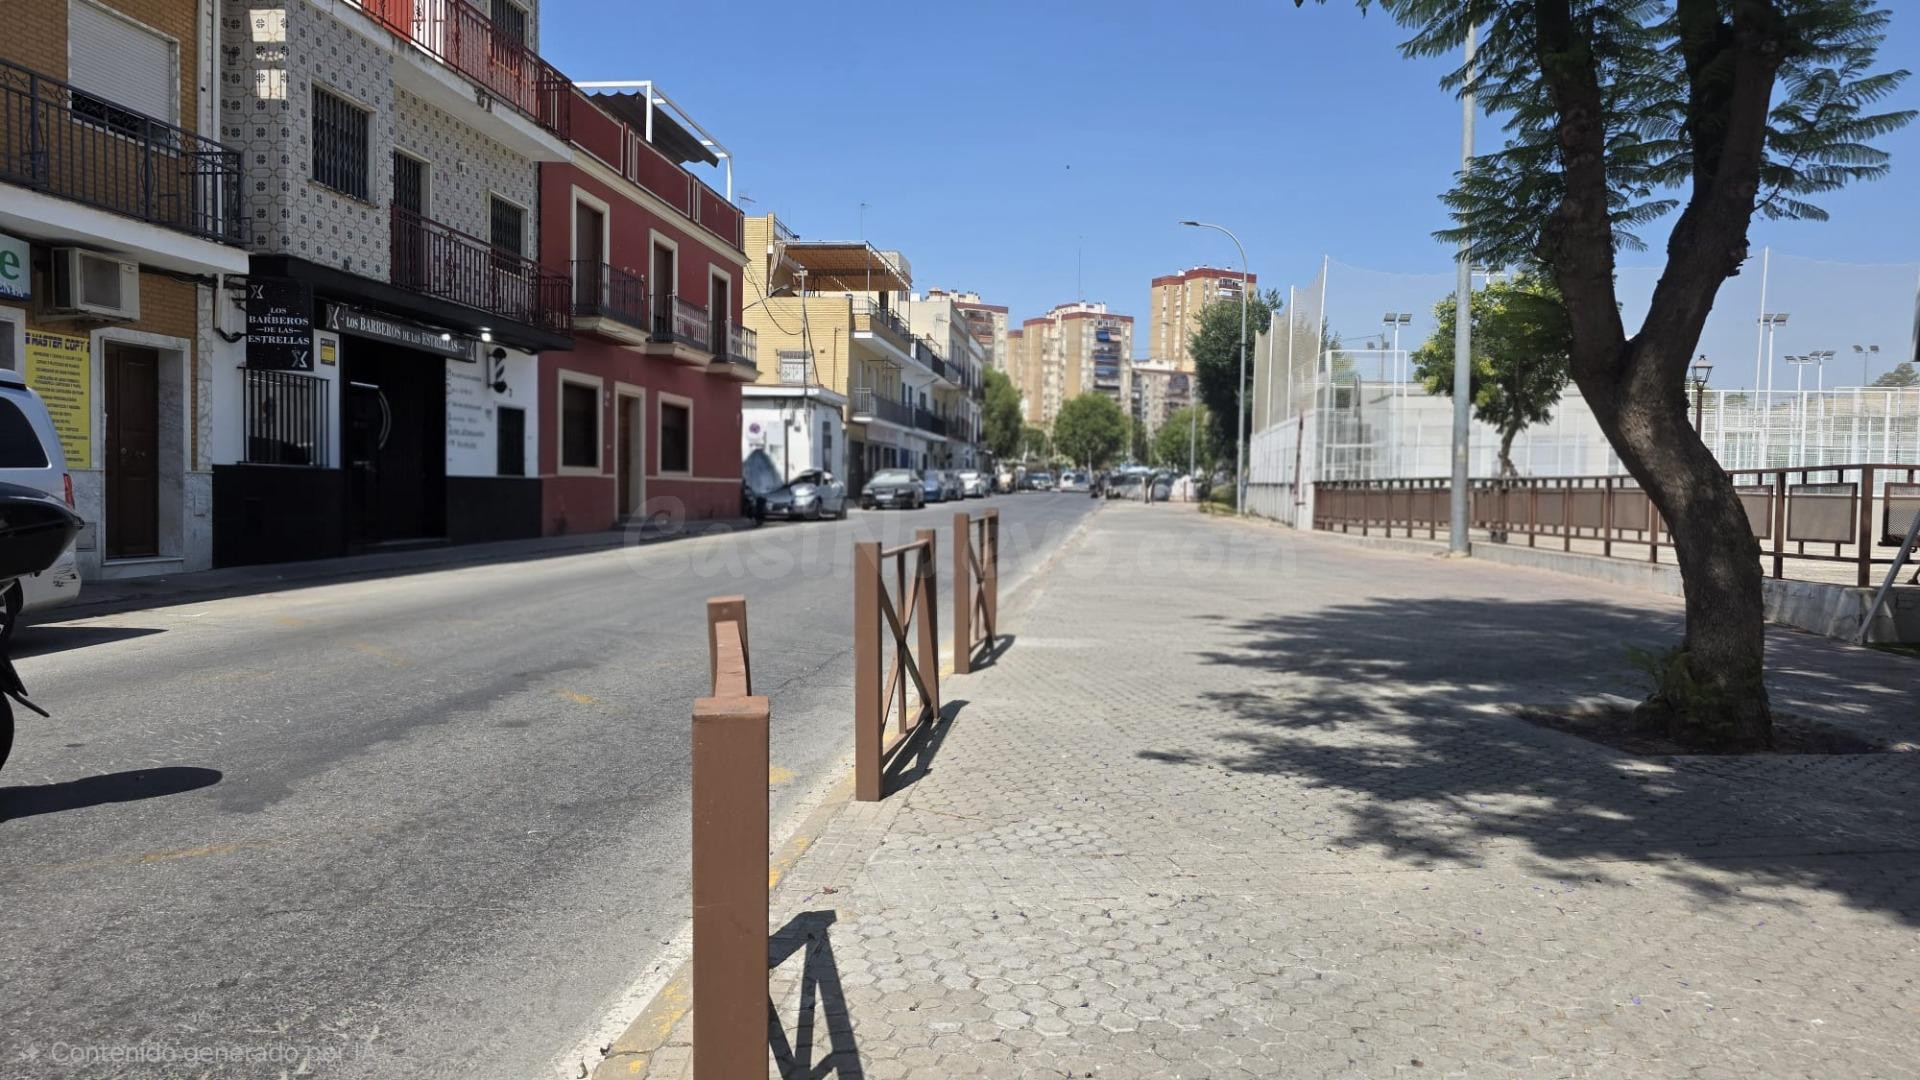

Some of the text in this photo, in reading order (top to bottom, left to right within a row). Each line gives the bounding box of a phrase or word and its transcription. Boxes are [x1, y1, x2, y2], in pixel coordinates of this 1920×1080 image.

[249, 315, 309, 326] BARBEROS
[346, 317, 359, 329] LOS
[360, 316, 401, 339] BARBEROS
[402, 331, 409, 341] DE
[421, 332, 458, 352] ESTRELLAS
[248, 335, 310, 345] ESTRELLAS
